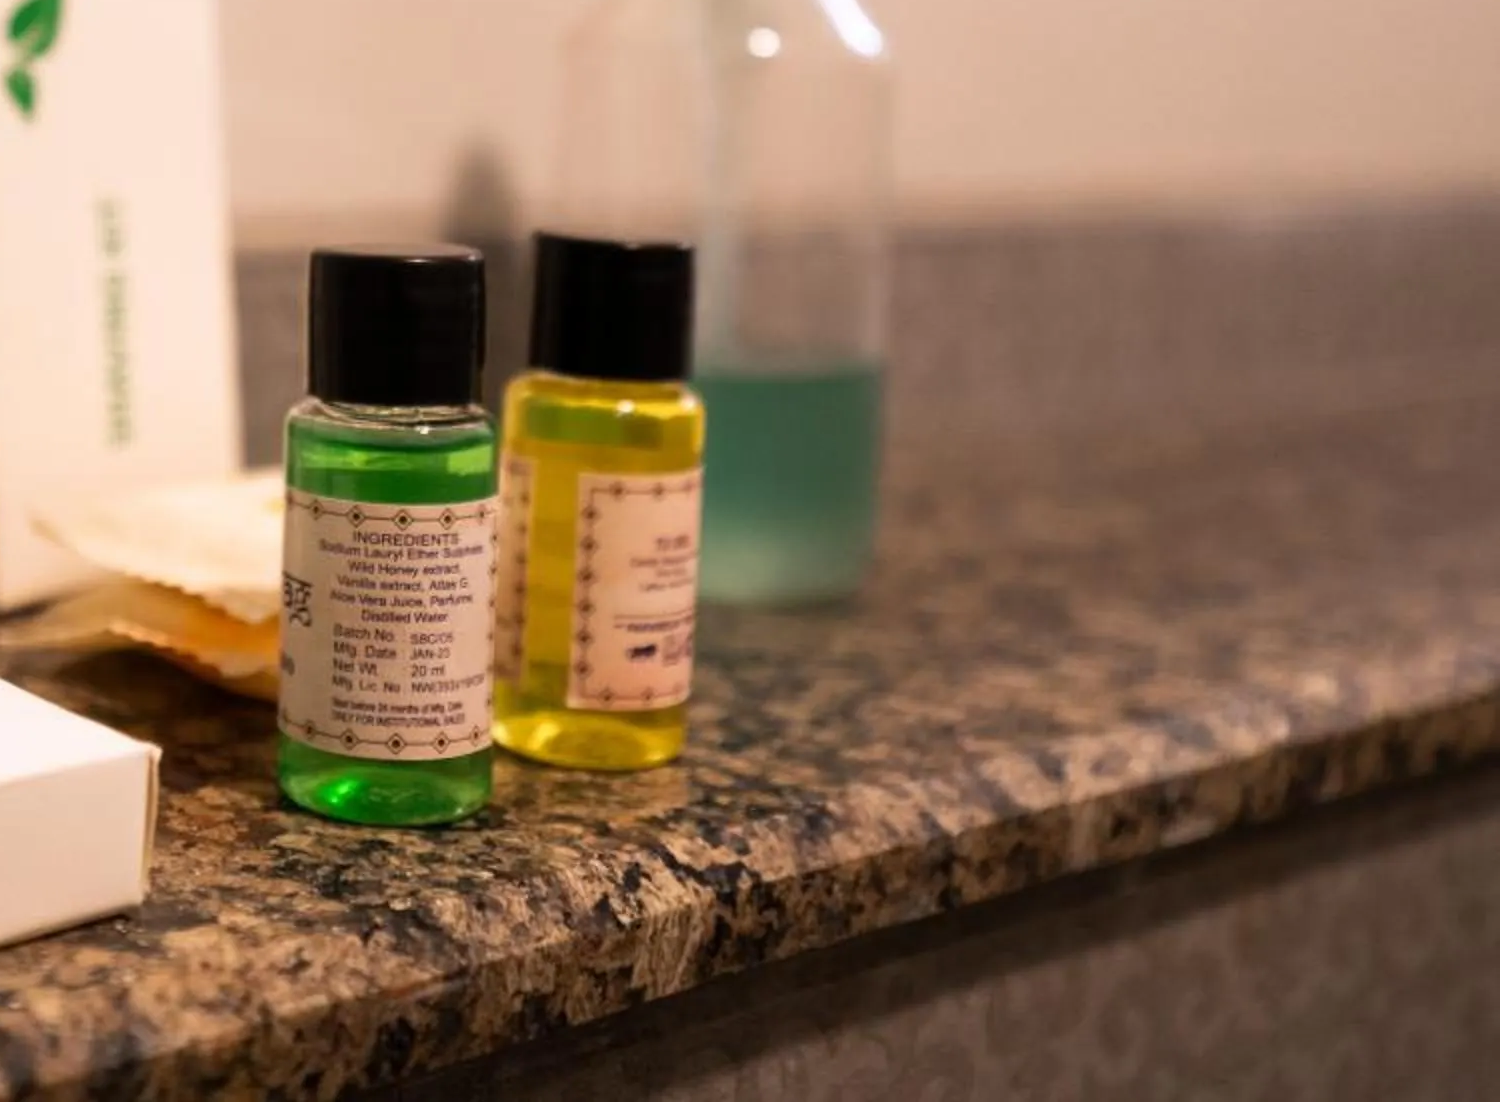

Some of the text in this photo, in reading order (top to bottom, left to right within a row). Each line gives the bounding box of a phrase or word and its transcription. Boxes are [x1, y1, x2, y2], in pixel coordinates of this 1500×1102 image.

[352, 530, 459, 546] INGREDIENTS
[377, 563, 419, 579] Honey
[358, 594, 387, 607] Vera
[360, 609, 449, 625] Distilled Water
[364, 645, 397, 659] Date
[411, 664, 427, 678] 20
